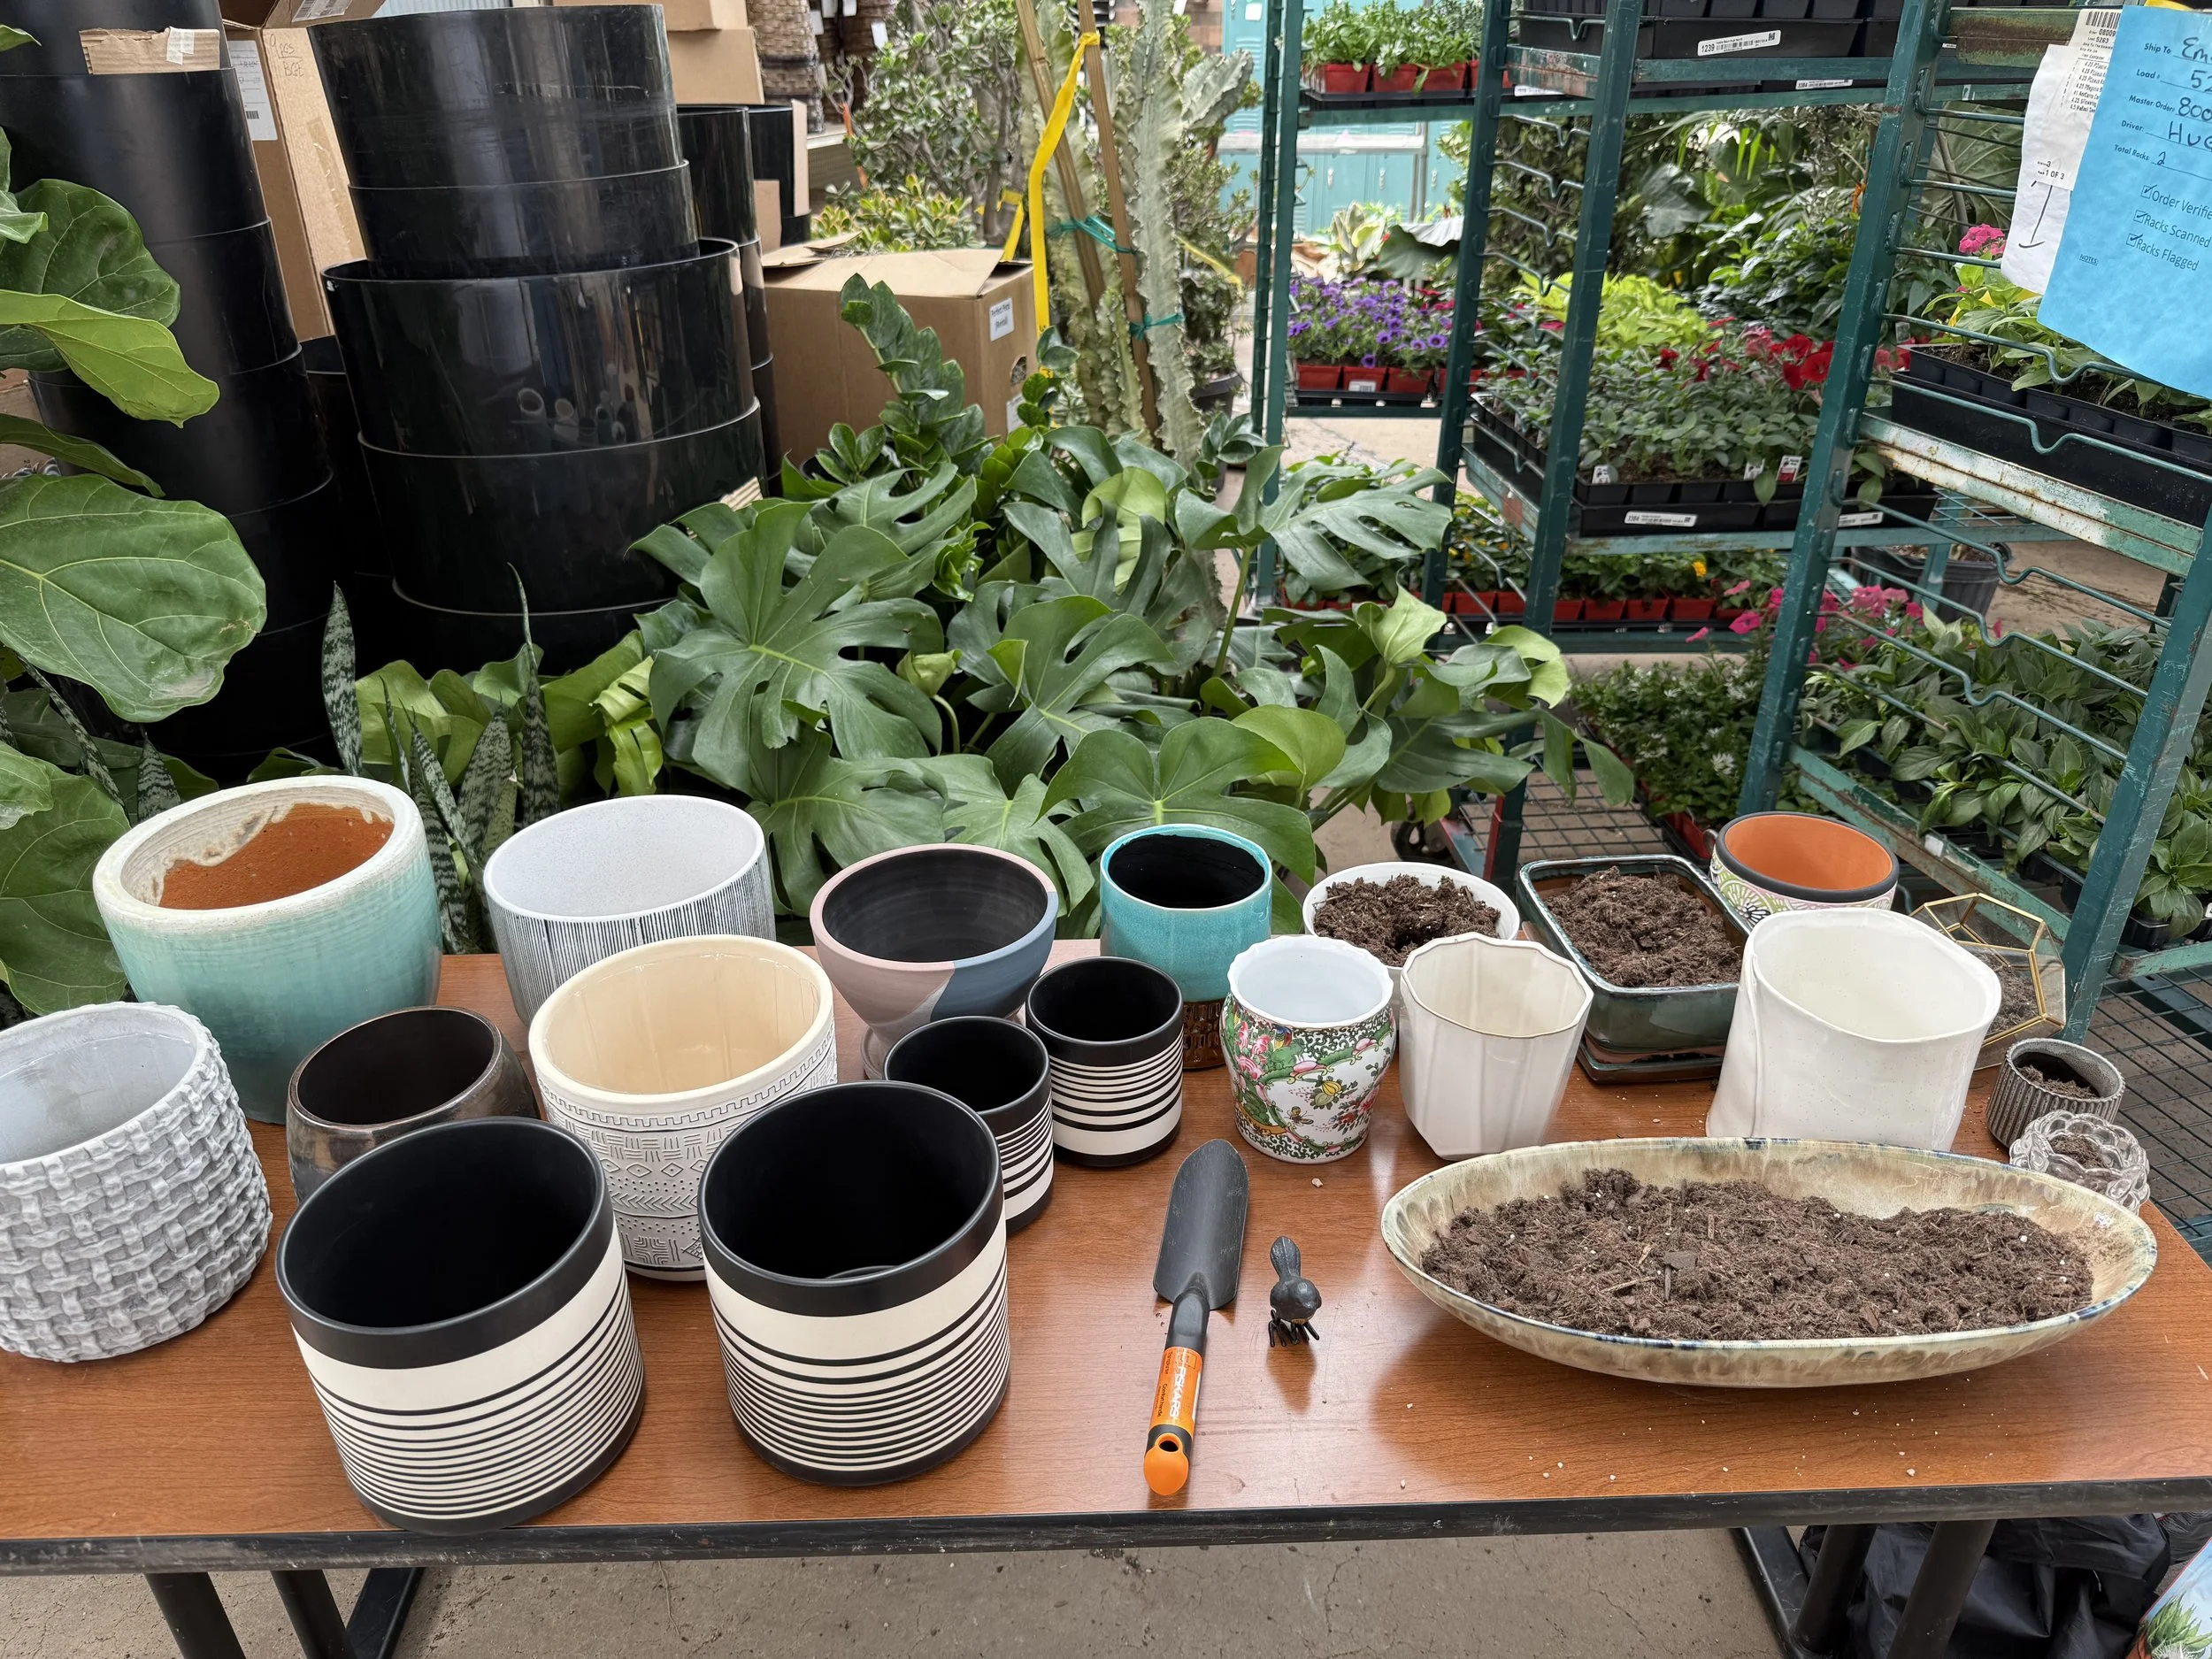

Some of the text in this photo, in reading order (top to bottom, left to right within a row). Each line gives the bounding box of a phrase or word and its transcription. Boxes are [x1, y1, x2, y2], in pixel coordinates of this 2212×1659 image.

[1701, 43, 1716, 53] 1239
[2144, 36, 2212, 65] Ship To Em
[2136, 69, 2156, 80] Load
[2128, 94, 2154, 107] Master
[2121, 119, 2145, 132] Driver:
[2114, 144, 2132, 155] Total
[2156, 151, 2166, 165] 2
[2050, 170, 2059, 179] OF
[2152, 190, 2180, 209] Order
[2144, 214, 2212, 248] Racks Scanned
[2136, 238, 2200, 271] Racks Flagged
